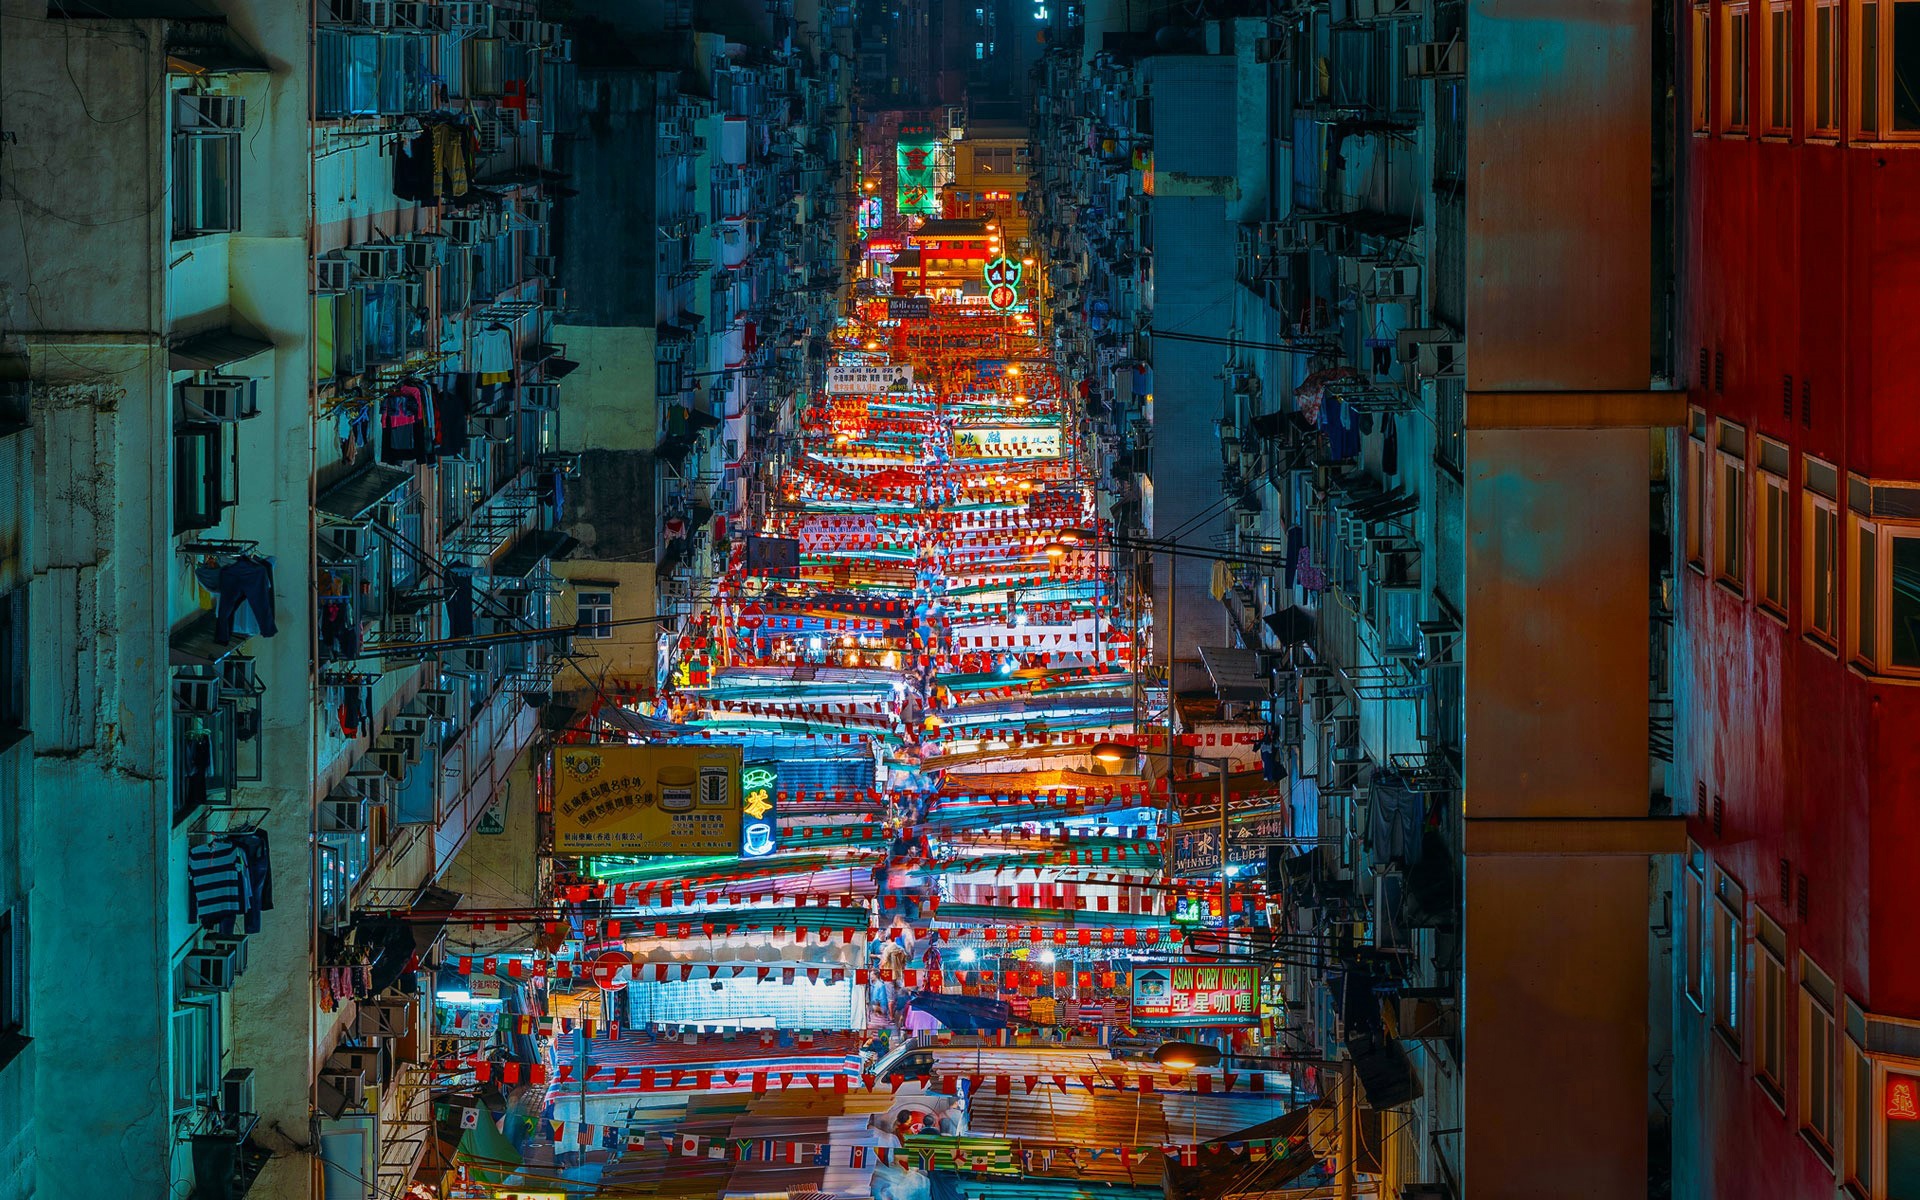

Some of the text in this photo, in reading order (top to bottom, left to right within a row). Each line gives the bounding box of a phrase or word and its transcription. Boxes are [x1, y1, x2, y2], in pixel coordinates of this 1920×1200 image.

[1172, 967, 1252, 990] ASIAN CURRY KITCHEN
[1172, 992, 1252, 1013] 亞星咖喱
